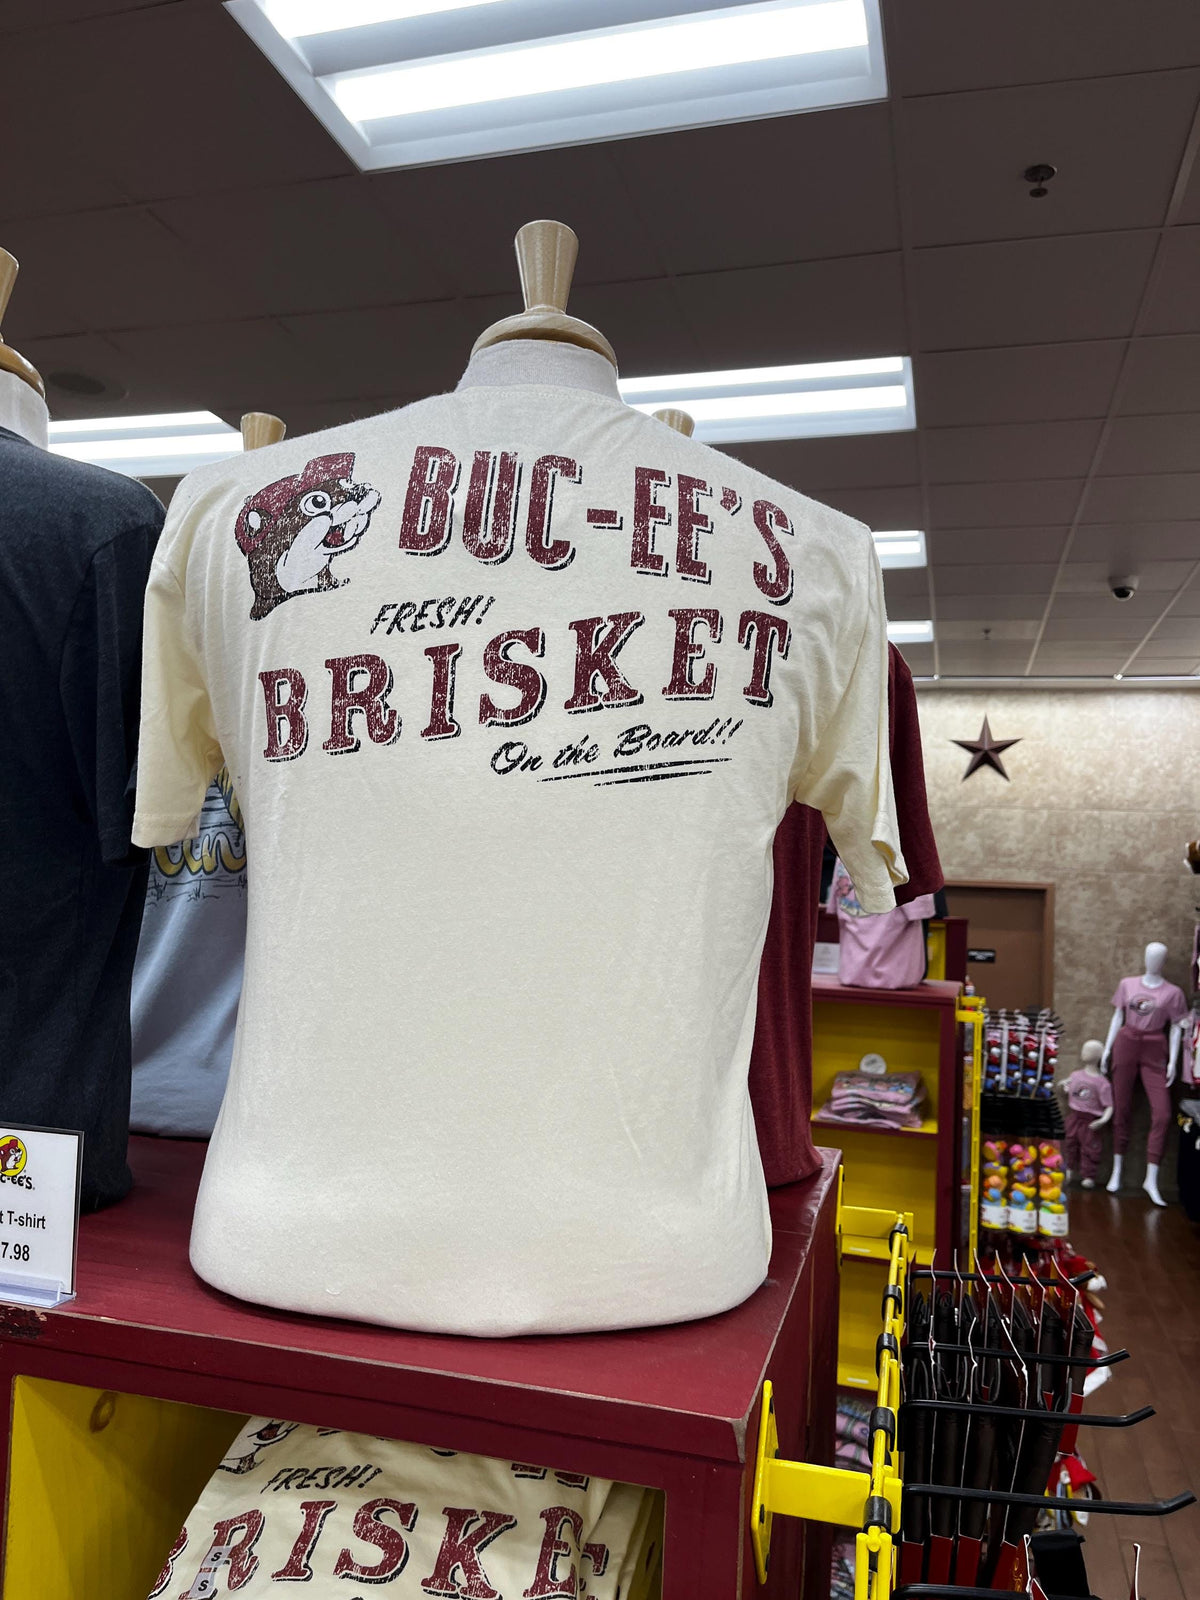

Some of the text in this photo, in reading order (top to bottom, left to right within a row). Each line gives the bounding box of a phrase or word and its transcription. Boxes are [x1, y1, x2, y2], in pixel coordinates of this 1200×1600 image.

[398, 445, 795, 606] BUC-EE'S
[369, 594, 496, 635] FRESH!
[257, 608, 792, 763] BRISKET
[490, 717, 744, 776] On the Board!!
[7, 1211, 45, 1229] T-shirt
[260, 1463, 383, 1494] FRESH!
[211, 1551, 222, 1562] S
[197, 1579, 209, 1592] S
